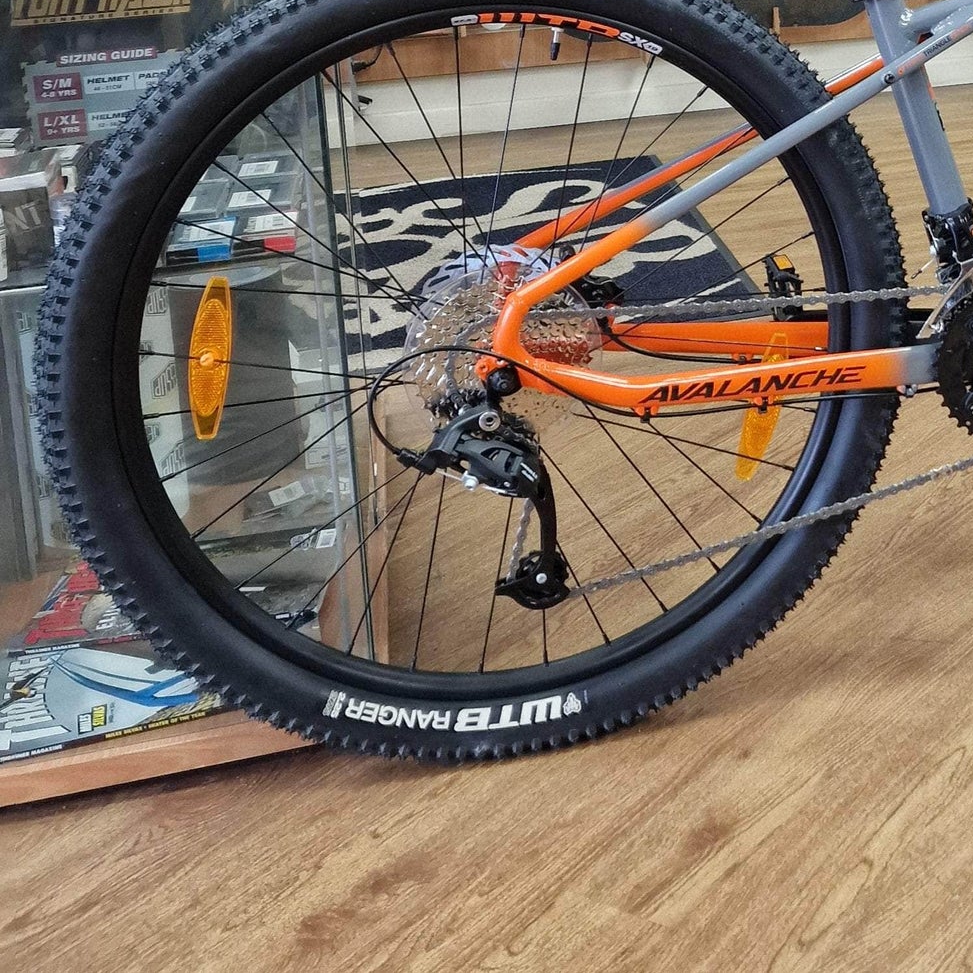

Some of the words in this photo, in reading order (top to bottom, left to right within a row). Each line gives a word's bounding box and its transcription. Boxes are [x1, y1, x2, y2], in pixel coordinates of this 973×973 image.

[922, 34, 952, 57] TRIANGLE
[60, 52, 108, 66] SIZING
[110, 47, 154, 61] GUIDE
[42, 77, 73, 90] S/M
[87, 74, 130, 85] HELMET
[43, 114, 81, 128] L/XL
[638, 365, 867, 404] AVALANCHE
[344, 696, 451, 730] RANGER
[452, 694, 563, 733] WTB
